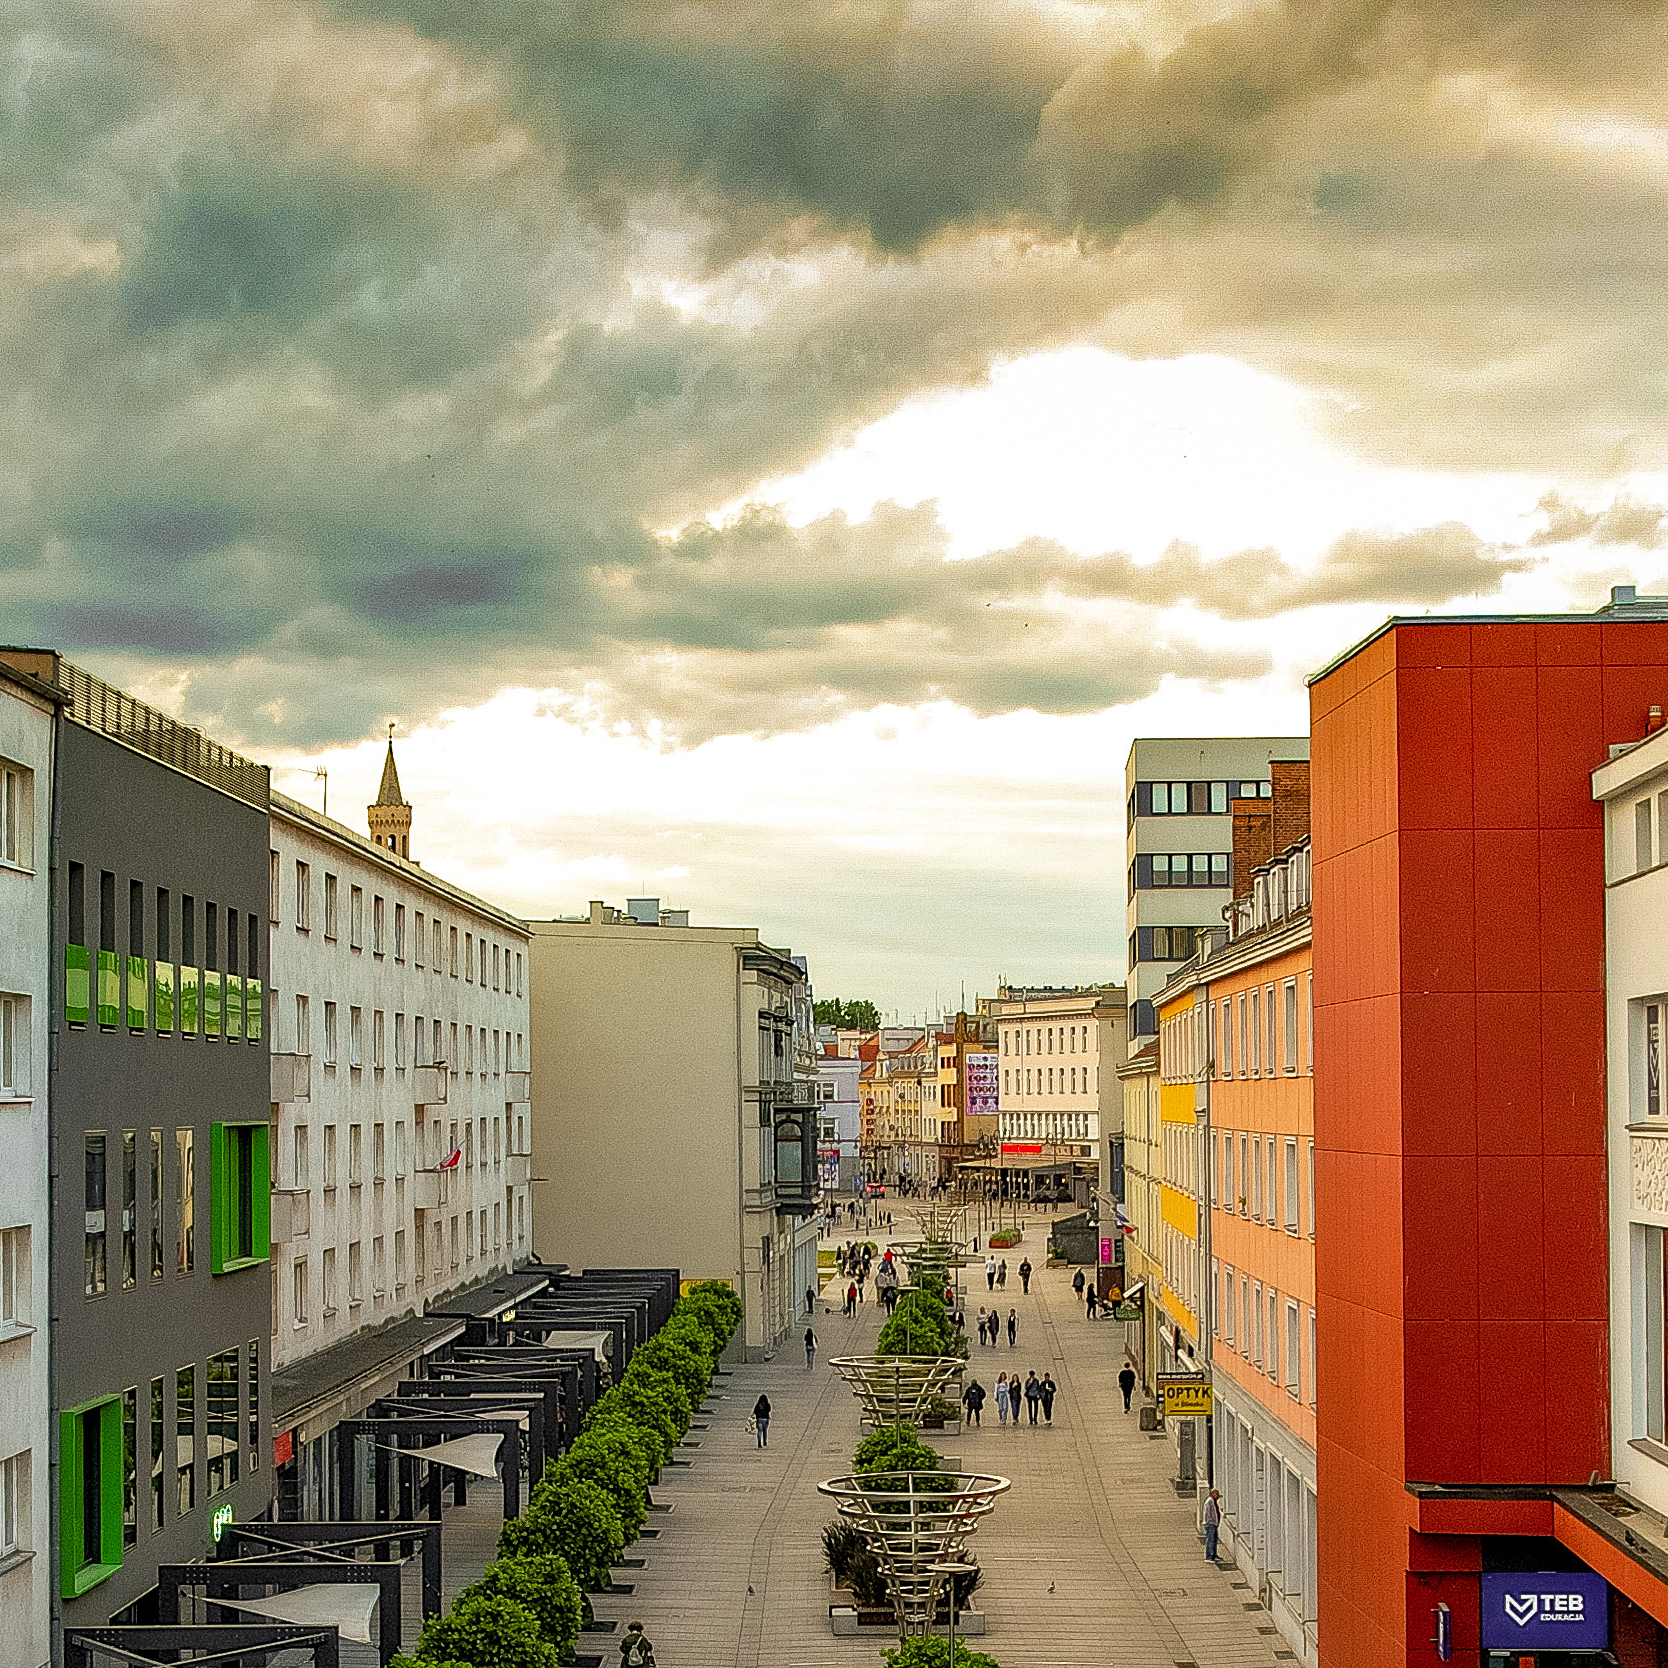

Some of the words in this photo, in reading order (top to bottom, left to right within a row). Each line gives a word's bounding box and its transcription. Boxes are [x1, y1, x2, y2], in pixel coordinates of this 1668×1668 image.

[1166, 1386, 1211, 1400] OPTYK
[1540, 1594, 1585, 1612] TEB
[1540, 1613, 1585, 1622] EDUKACJA
